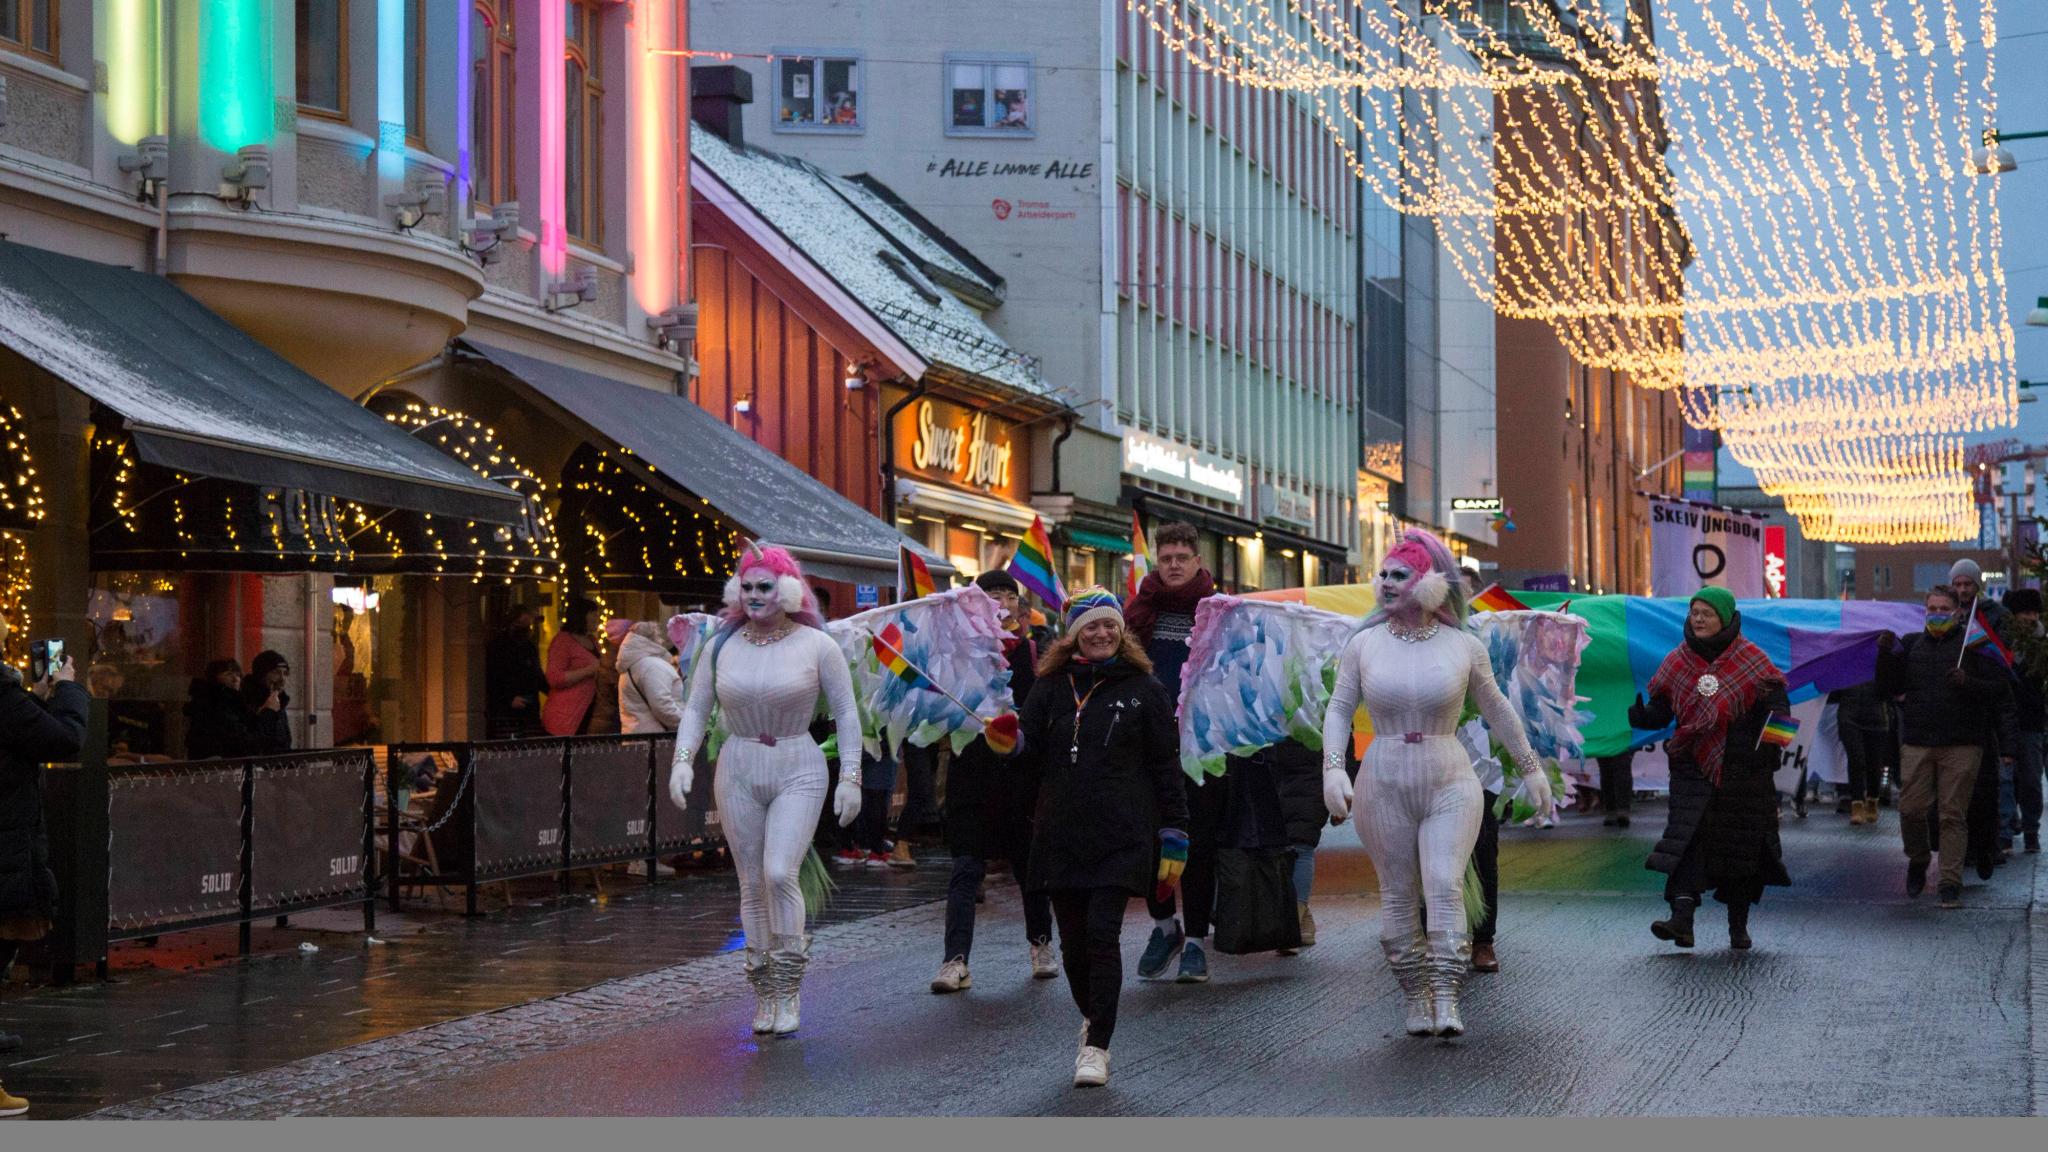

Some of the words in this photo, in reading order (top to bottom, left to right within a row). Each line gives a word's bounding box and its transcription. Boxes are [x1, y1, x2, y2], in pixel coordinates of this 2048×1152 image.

[992, 163, 1042, 175] LAMME
[1044, 160, 1094, 179] ALLE
[914, 400, 965, 473] Sweet
[964, 411, 1011, 488] Heart
[1453, 499, 1500, 510] GANT
[1653, 504, 1699, 528] SKEIV
[1701, 516, 1761, 543] UNGDOM
[538, 828, 558, 846] SOLID
[627, 819, 645, 836] SOLID
[330, 855, 358, 877] SOLID
[201, 873, 232, 895] SOLID
